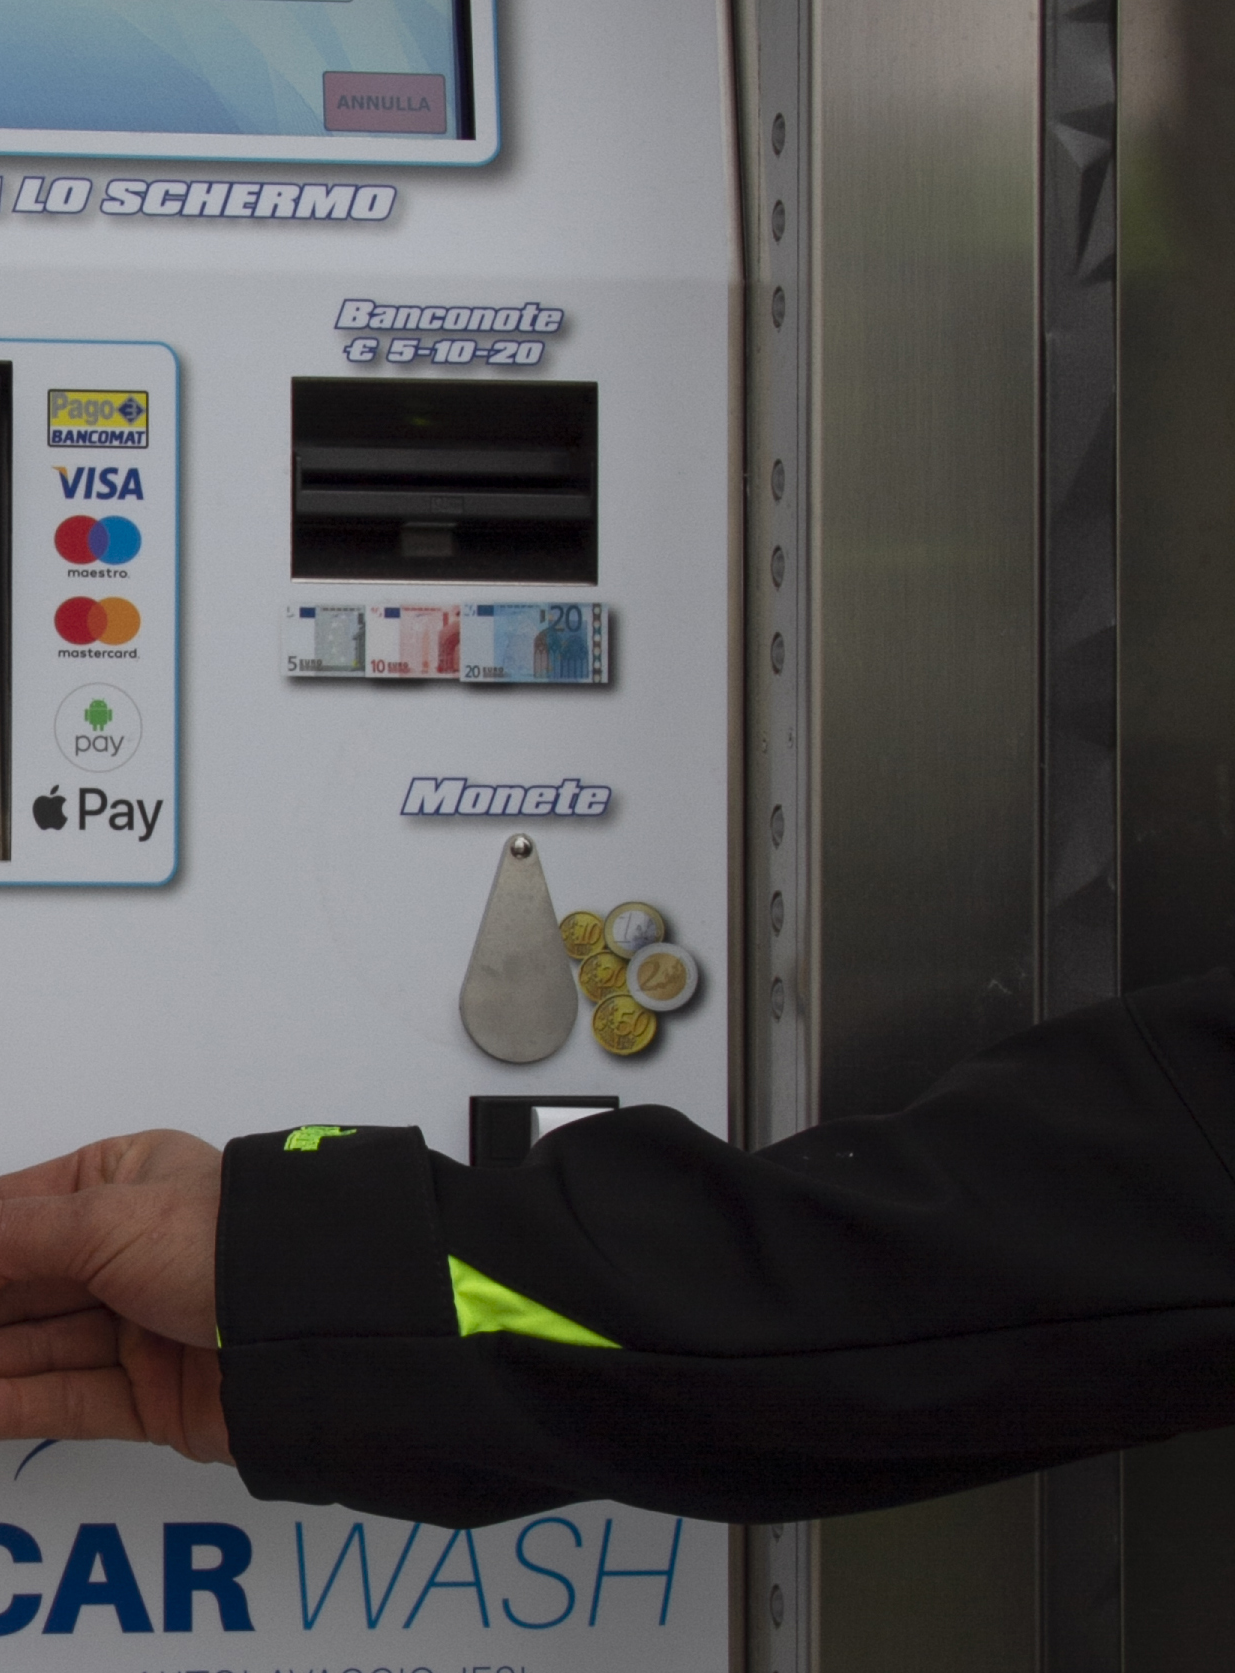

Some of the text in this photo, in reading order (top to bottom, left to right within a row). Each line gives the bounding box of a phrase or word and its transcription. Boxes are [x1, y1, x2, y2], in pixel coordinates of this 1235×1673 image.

[337, 94, 431, 112] ANNULLA
[12, 176, 93, 213] LO
[100, 179, 397, 221] SCHERMO
[334, 298, 564, 333] Banconote
[343, 337, 545, 365] € 5-10-20
[51, 391, 114, 425] Pago
[52, 430, 145, 444] BANCOMAT
[53, 467, 144, 500] VISA
[550, 605, 582, 632] 20
[288, 655, 298, 672] 5
[371, 659, 385, 673] 10
[465, 665, 480, 678] 20
[75, 735, 125, 757] pay
[400, 777, 612, 817] Monete
[79, 788, 163, 842] Pay
[294, 1517, 682, 1631] WASH
